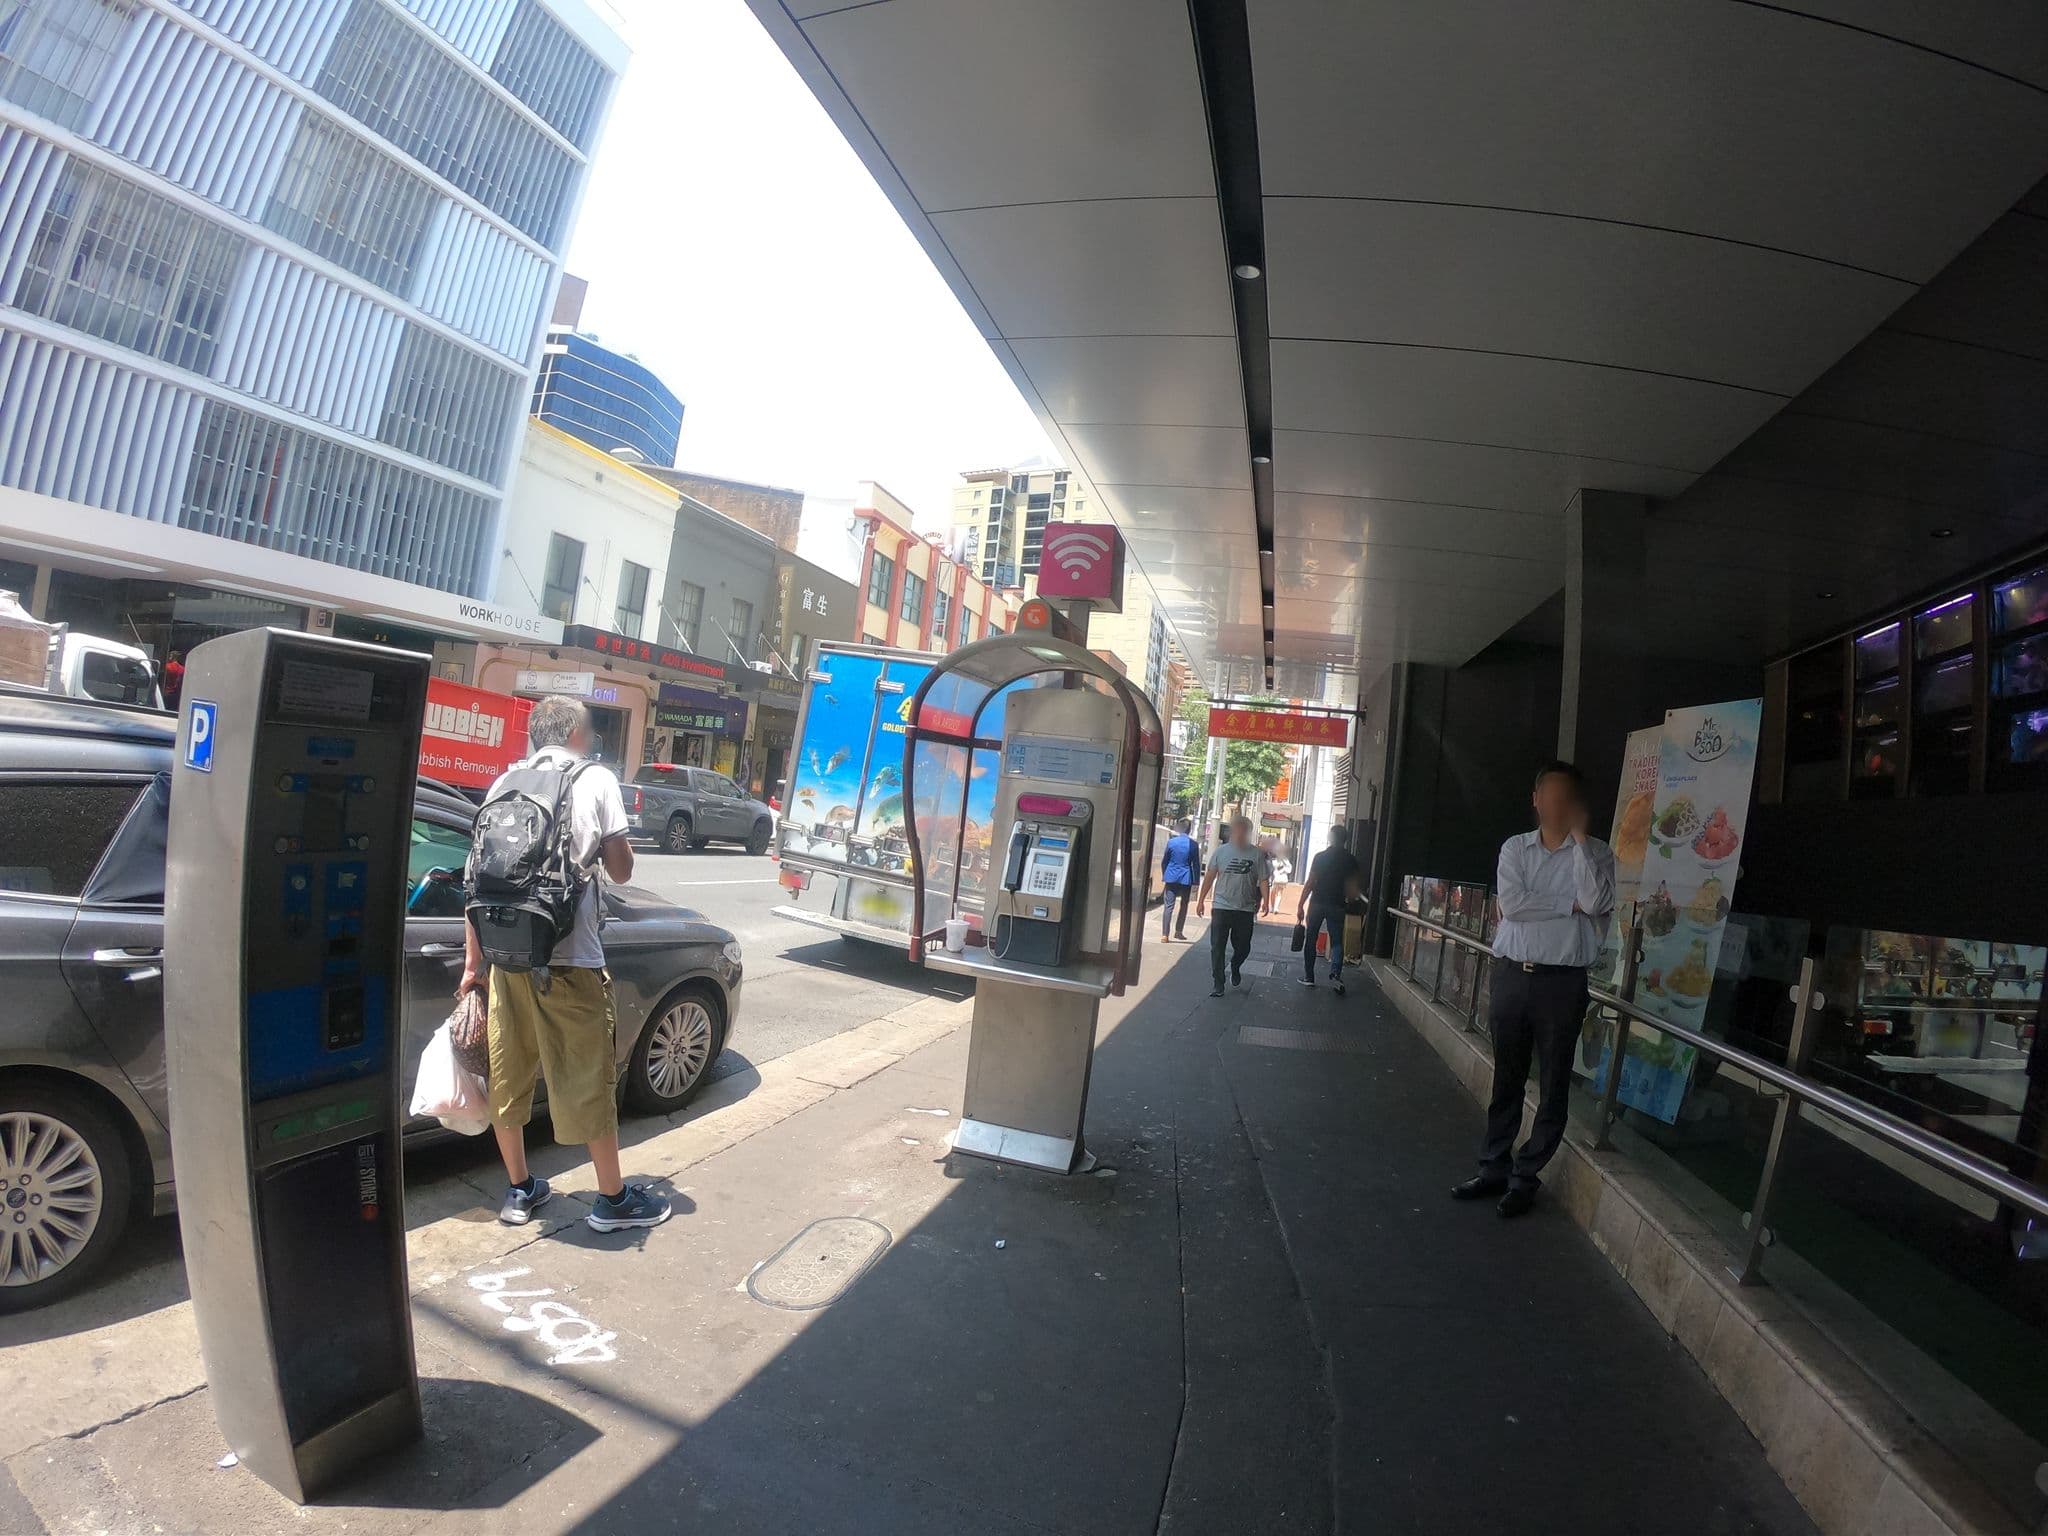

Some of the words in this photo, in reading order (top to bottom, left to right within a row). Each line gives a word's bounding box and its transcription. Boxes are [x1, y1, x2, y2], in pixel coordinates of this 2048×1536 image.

[803, 587, 827, 616] 富生
[460, 603, 541, 633] WORKHOUSE
[664, 713, 693, 723] WAMADA
[189, 708, 210, 760] P
[882, 722, 906, 734] GOLDE
[454, 757, 499, 776] Removal
[1630, 755, 1661, 769] TRADITI
[1636, 767, 1658, 780] KORE
[1634, 780, 1657, 792] SNAC
[359, 1144, 375, 1157] CITY
[360, 1168, 377, 1205] SYDNEY
